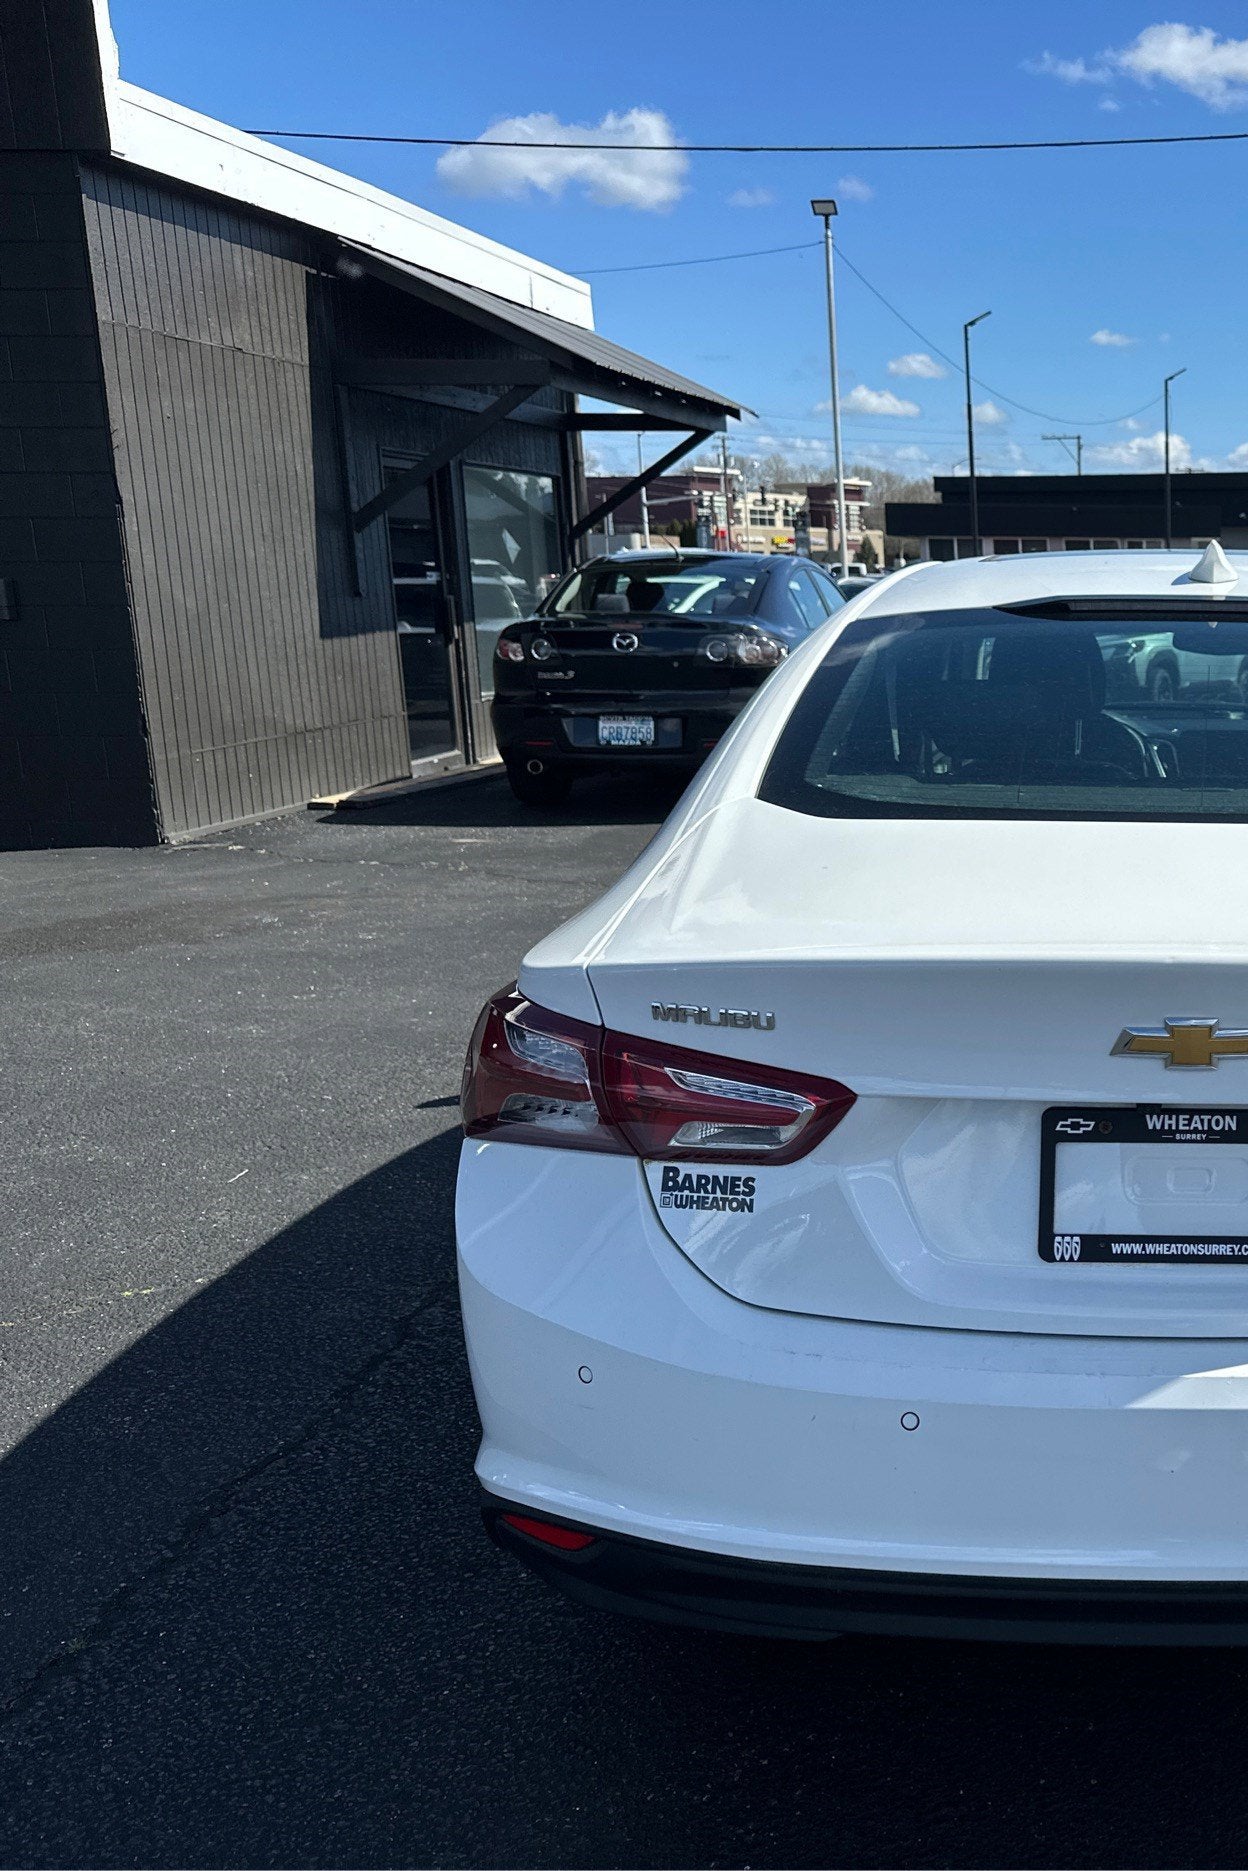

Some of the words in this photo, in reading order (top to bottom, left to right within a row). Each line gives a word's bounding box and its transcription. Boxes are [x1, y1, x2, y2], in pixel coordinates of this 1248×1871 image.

[651, 1001, 776, 1030] MALIBU
[1146, 1114, 1238, 1131] WHEATON
[1175, 1133, 1207, 1141] SURREY
[661, 1166, 756, 1197] BARNES
[674, 1194, 755, 1213] WHEATON
